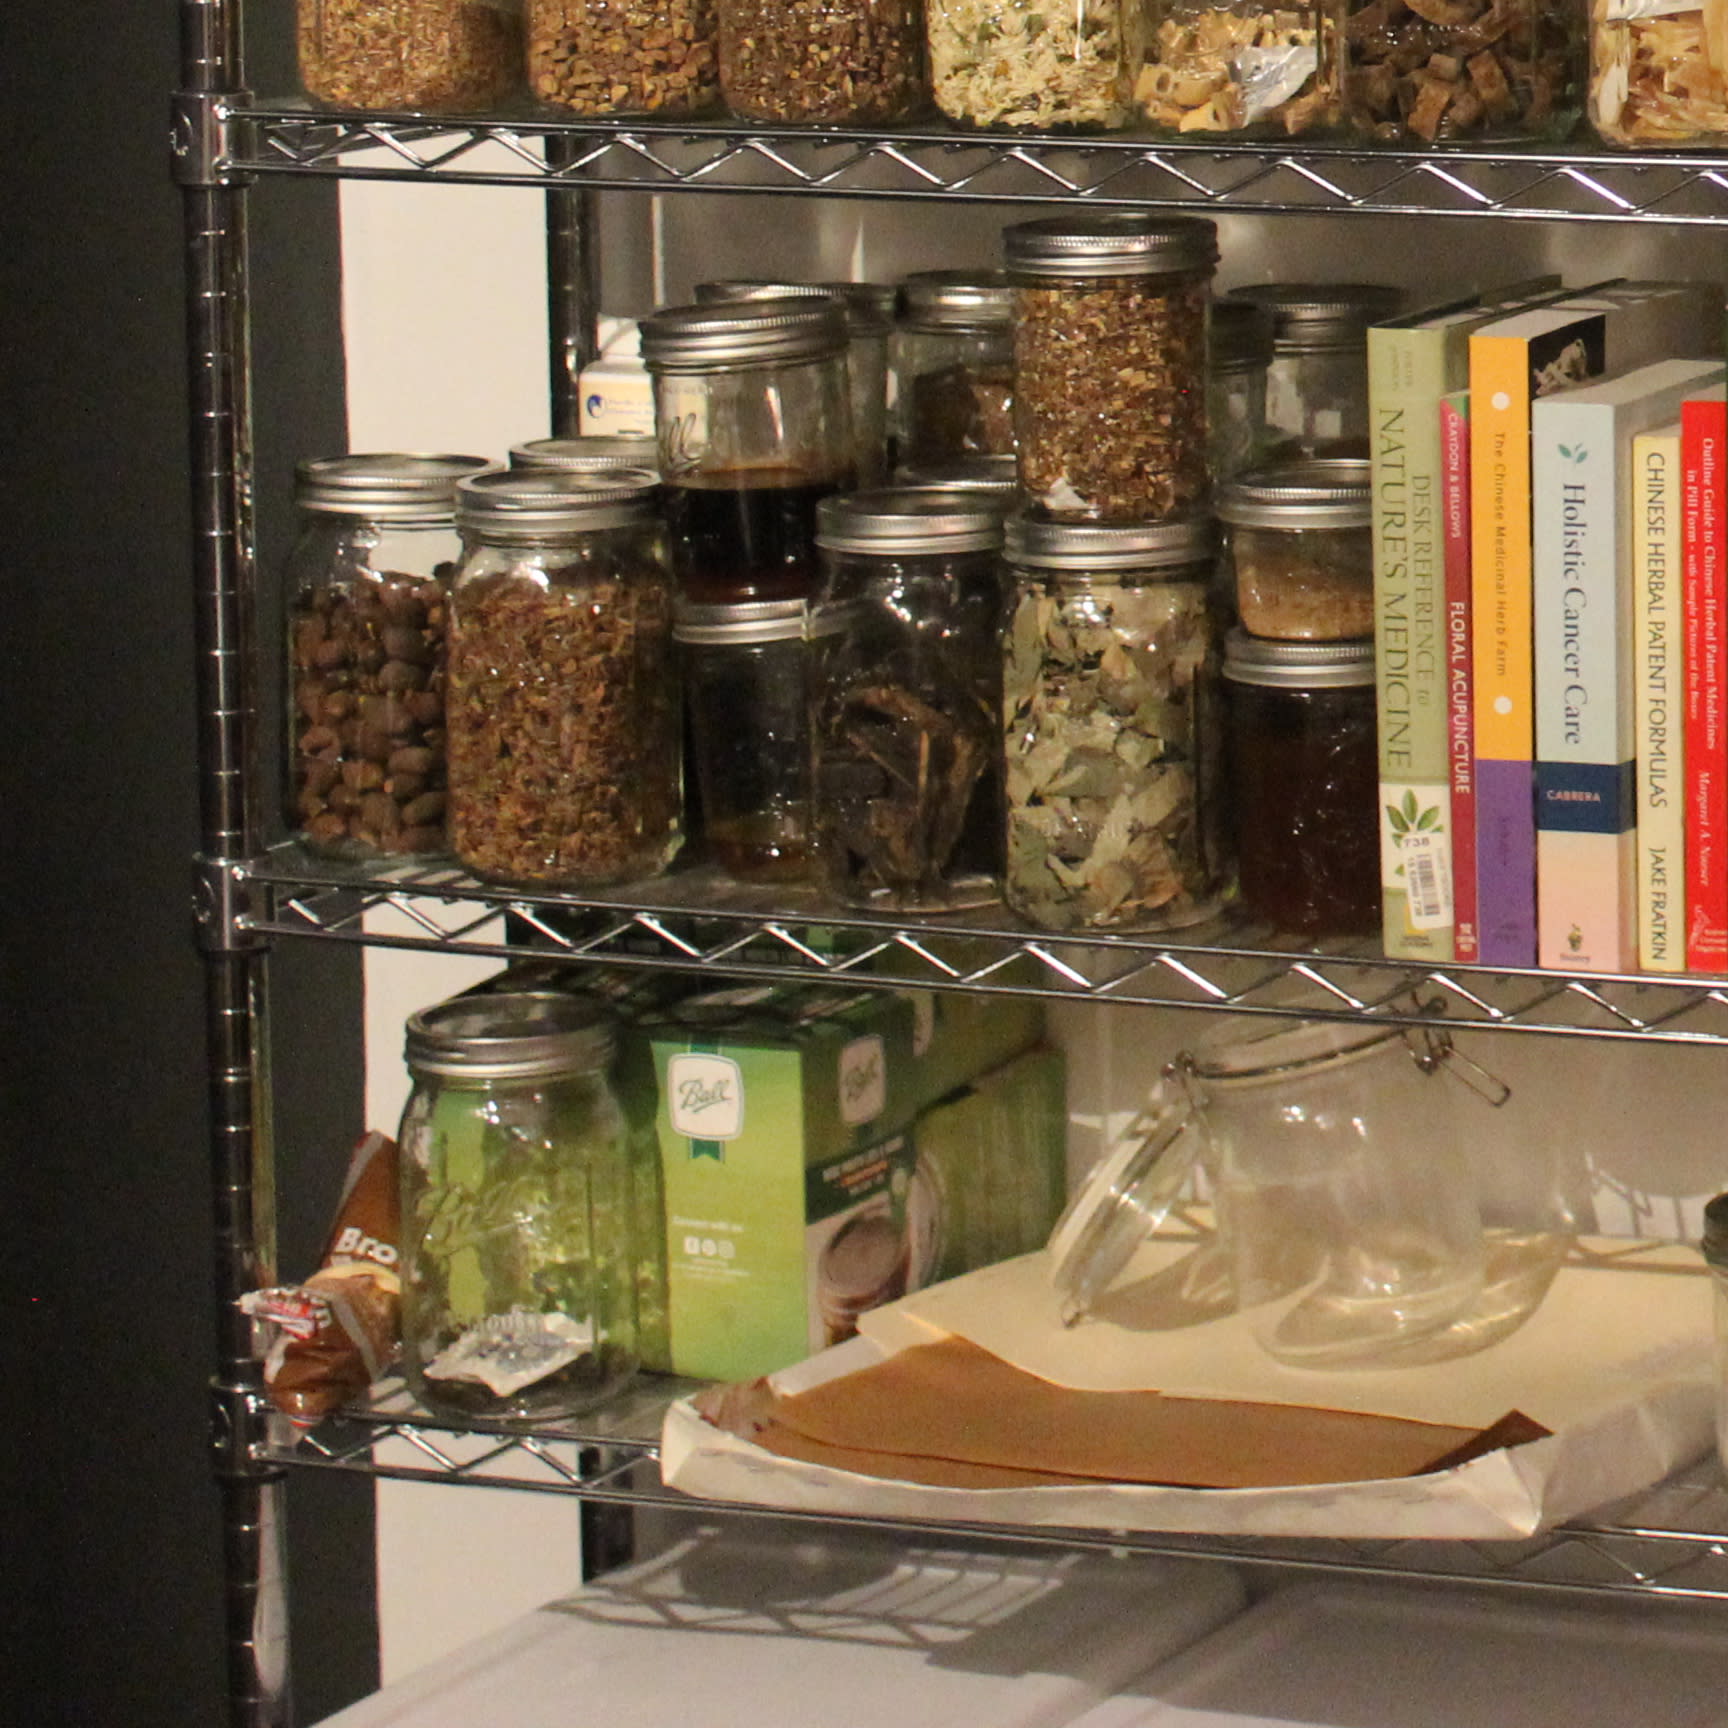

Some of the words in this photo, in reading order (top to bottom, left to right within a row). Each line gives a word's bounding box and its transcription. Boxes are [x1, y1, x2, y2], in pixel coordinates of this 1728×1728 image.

[1494, 432, 1506, 458] The
[1702, 437, 1715, 486] Outline
[1379, 408, 1408, 579] NATURE'S
[1412, 475, 1432, 534] DESK
[1494, 461, 1507, 521] Chinese
[1646, 451, 1665, 536] CHINESE
[1702, 488, 1716, 528] Guide
[1562, 482, 1588, 580] Holistic
[1686, 510, 1699, 544] Form
[1702, 530, 1714, 543] to
[1494, 526, 1508, 595] Medicinal
[1647, 540, 1666, 615] HERBAL
[1703, 545, 1717, 597] Chinese
[1413, 541, 1436, 680] REFERENCE
[1450, 601, 1466, 663] FLORAL
[1496, 599, 1508, 635] Herb
[1563, 587, 1588, 677] Cancer
[1703, 598, 1718, 642] Herbal
[1384, 592, 1412, 769] MEDICINE
[1497, 639, 1509, 677] Farm
[1647, 619, 1667, 693] PATENT
[1704, 644, 1719, 684] Patent
[1452, 669, 1471, 795] ACUPUNCTURE
[1563, 684, 1589, 745] Care
[1705, 686, 1722, 751] Medicines
[1647, 698, 1668, 809] FORMULAS
[1546, 789, 1601, 802] CABRERA
[1648, 847, 1667, 887] JAKE
[1650, 891, 1667, 961] FRATKIN
[679, 1078, 733, 1113] Ball
